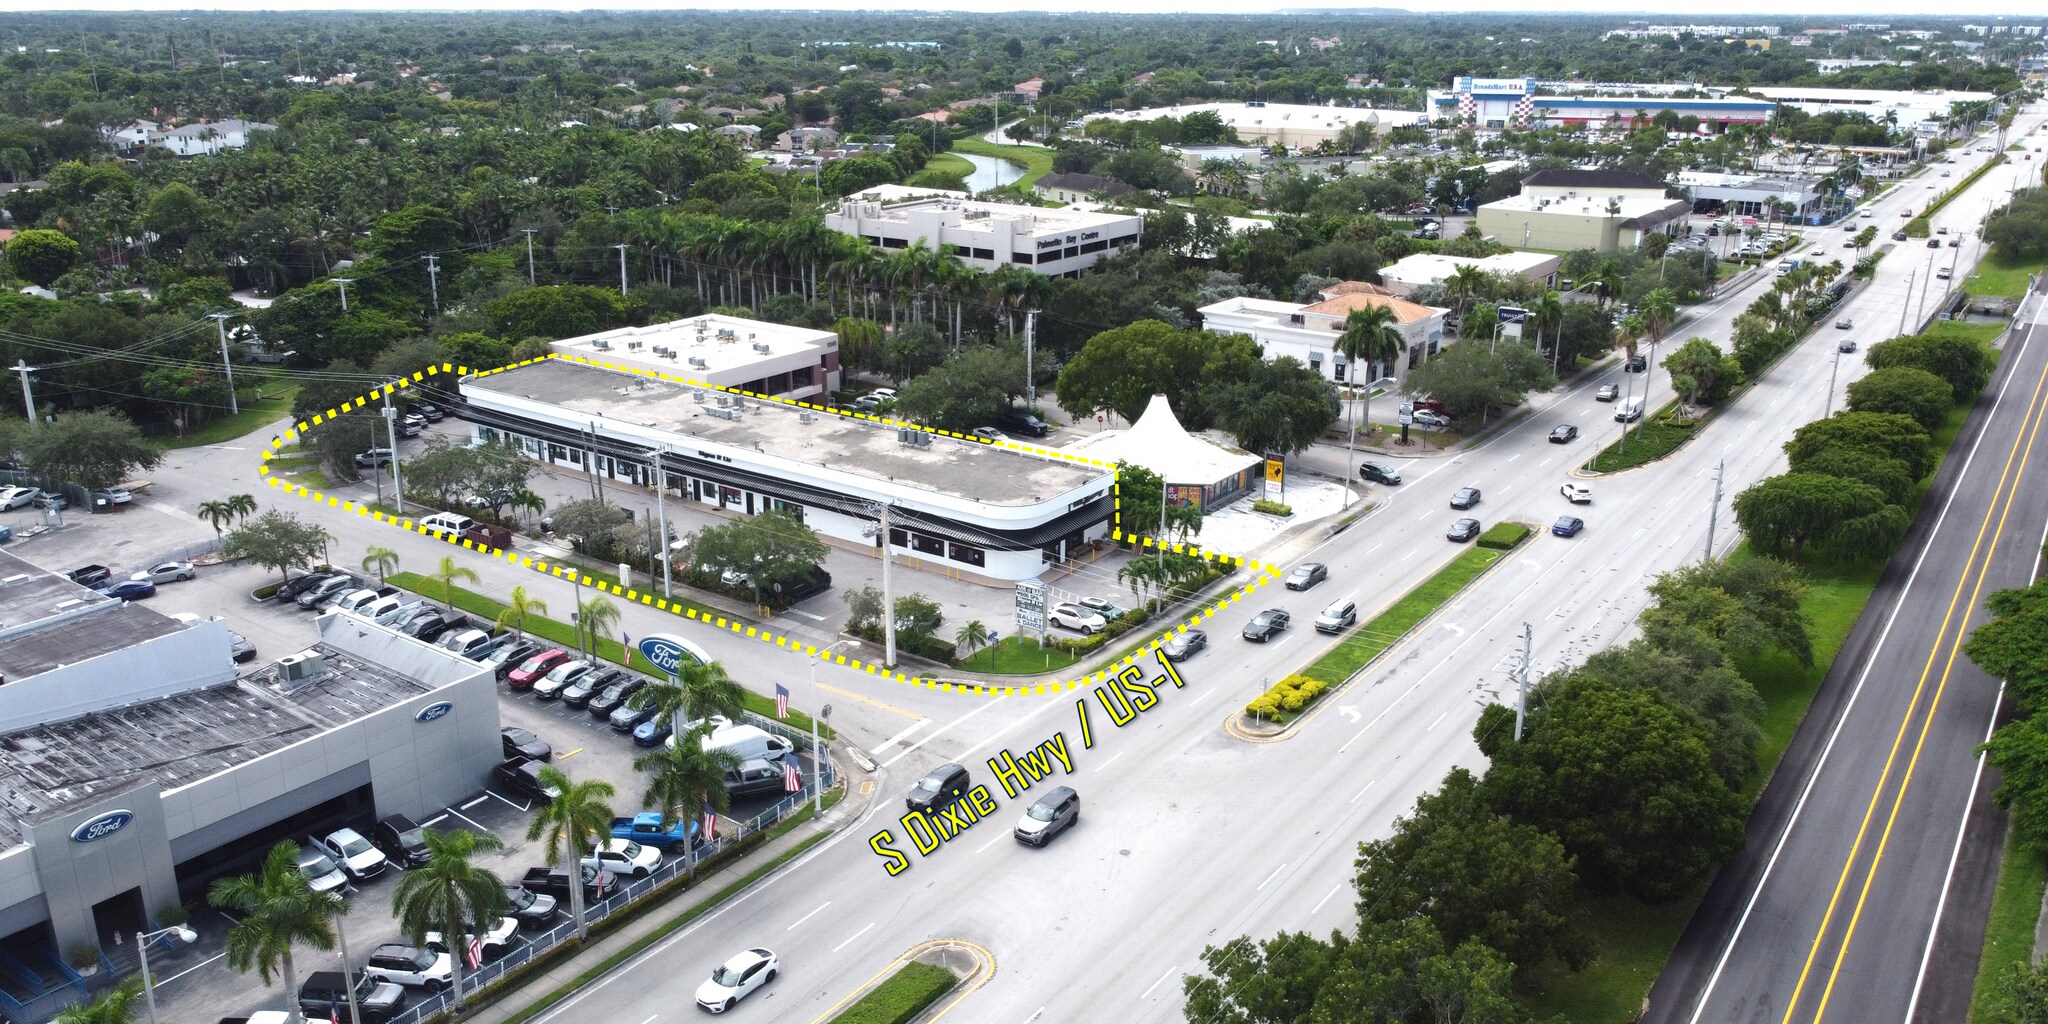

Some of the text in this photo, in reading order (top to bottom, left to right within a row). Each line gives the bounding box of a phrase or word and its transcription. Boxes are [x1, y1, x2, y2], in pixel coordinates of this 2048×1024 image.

[1037, 231, 1099, 249] Palmetto Bay Centre
[1017, 612, 1042, 624] BALLET
[1022, 620, 1042, 629] DANCE
[426, 706, 446, 720] Ford
[87, 817, 122, 839] Ford
